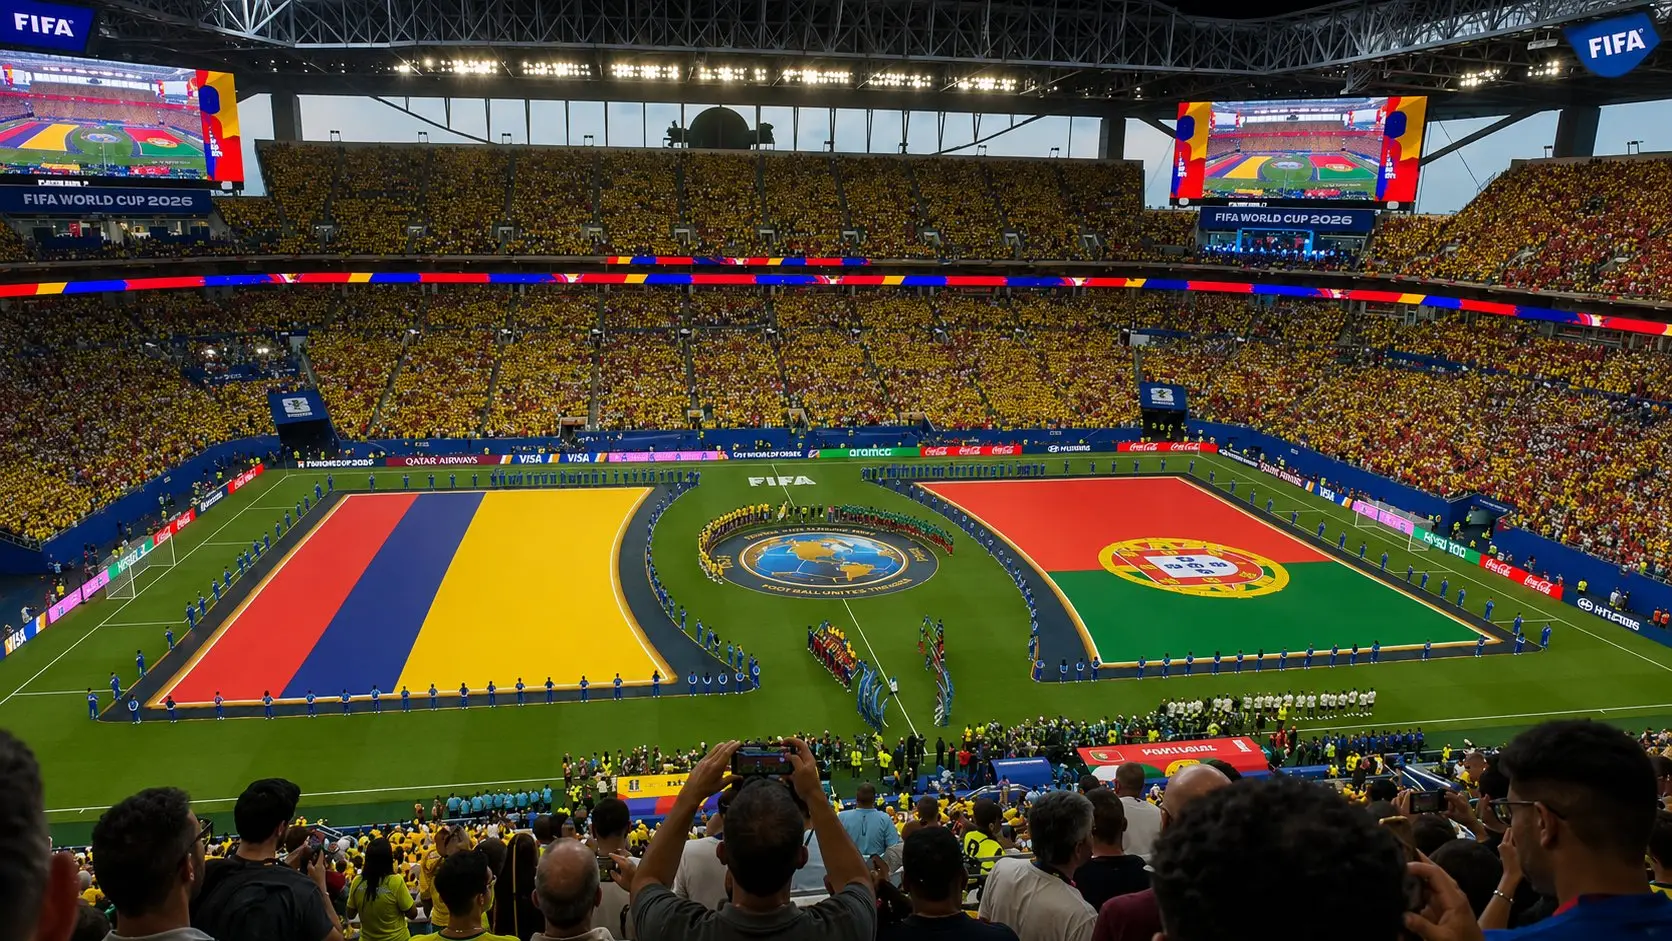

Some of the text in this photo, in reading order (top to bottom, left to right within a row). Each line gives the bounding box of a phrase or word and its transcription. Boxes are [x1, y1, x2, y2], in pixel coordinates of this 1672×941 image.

[14, 12, 74, 38] FIFA
[1589, 29, 1646, 59] FIFA
[23, 193, 193, 207] FIFA WORLD CUP 2026
[1215, 213, 1352, 225] FIFA WORLD CUP 2026
[405, 456, 478, 466] QATAR AIRWAYS
[518, 453, 542, 464] VISA
[567, 453, 590, 463] VISA
[747, 475, 817, 487] FIFA
